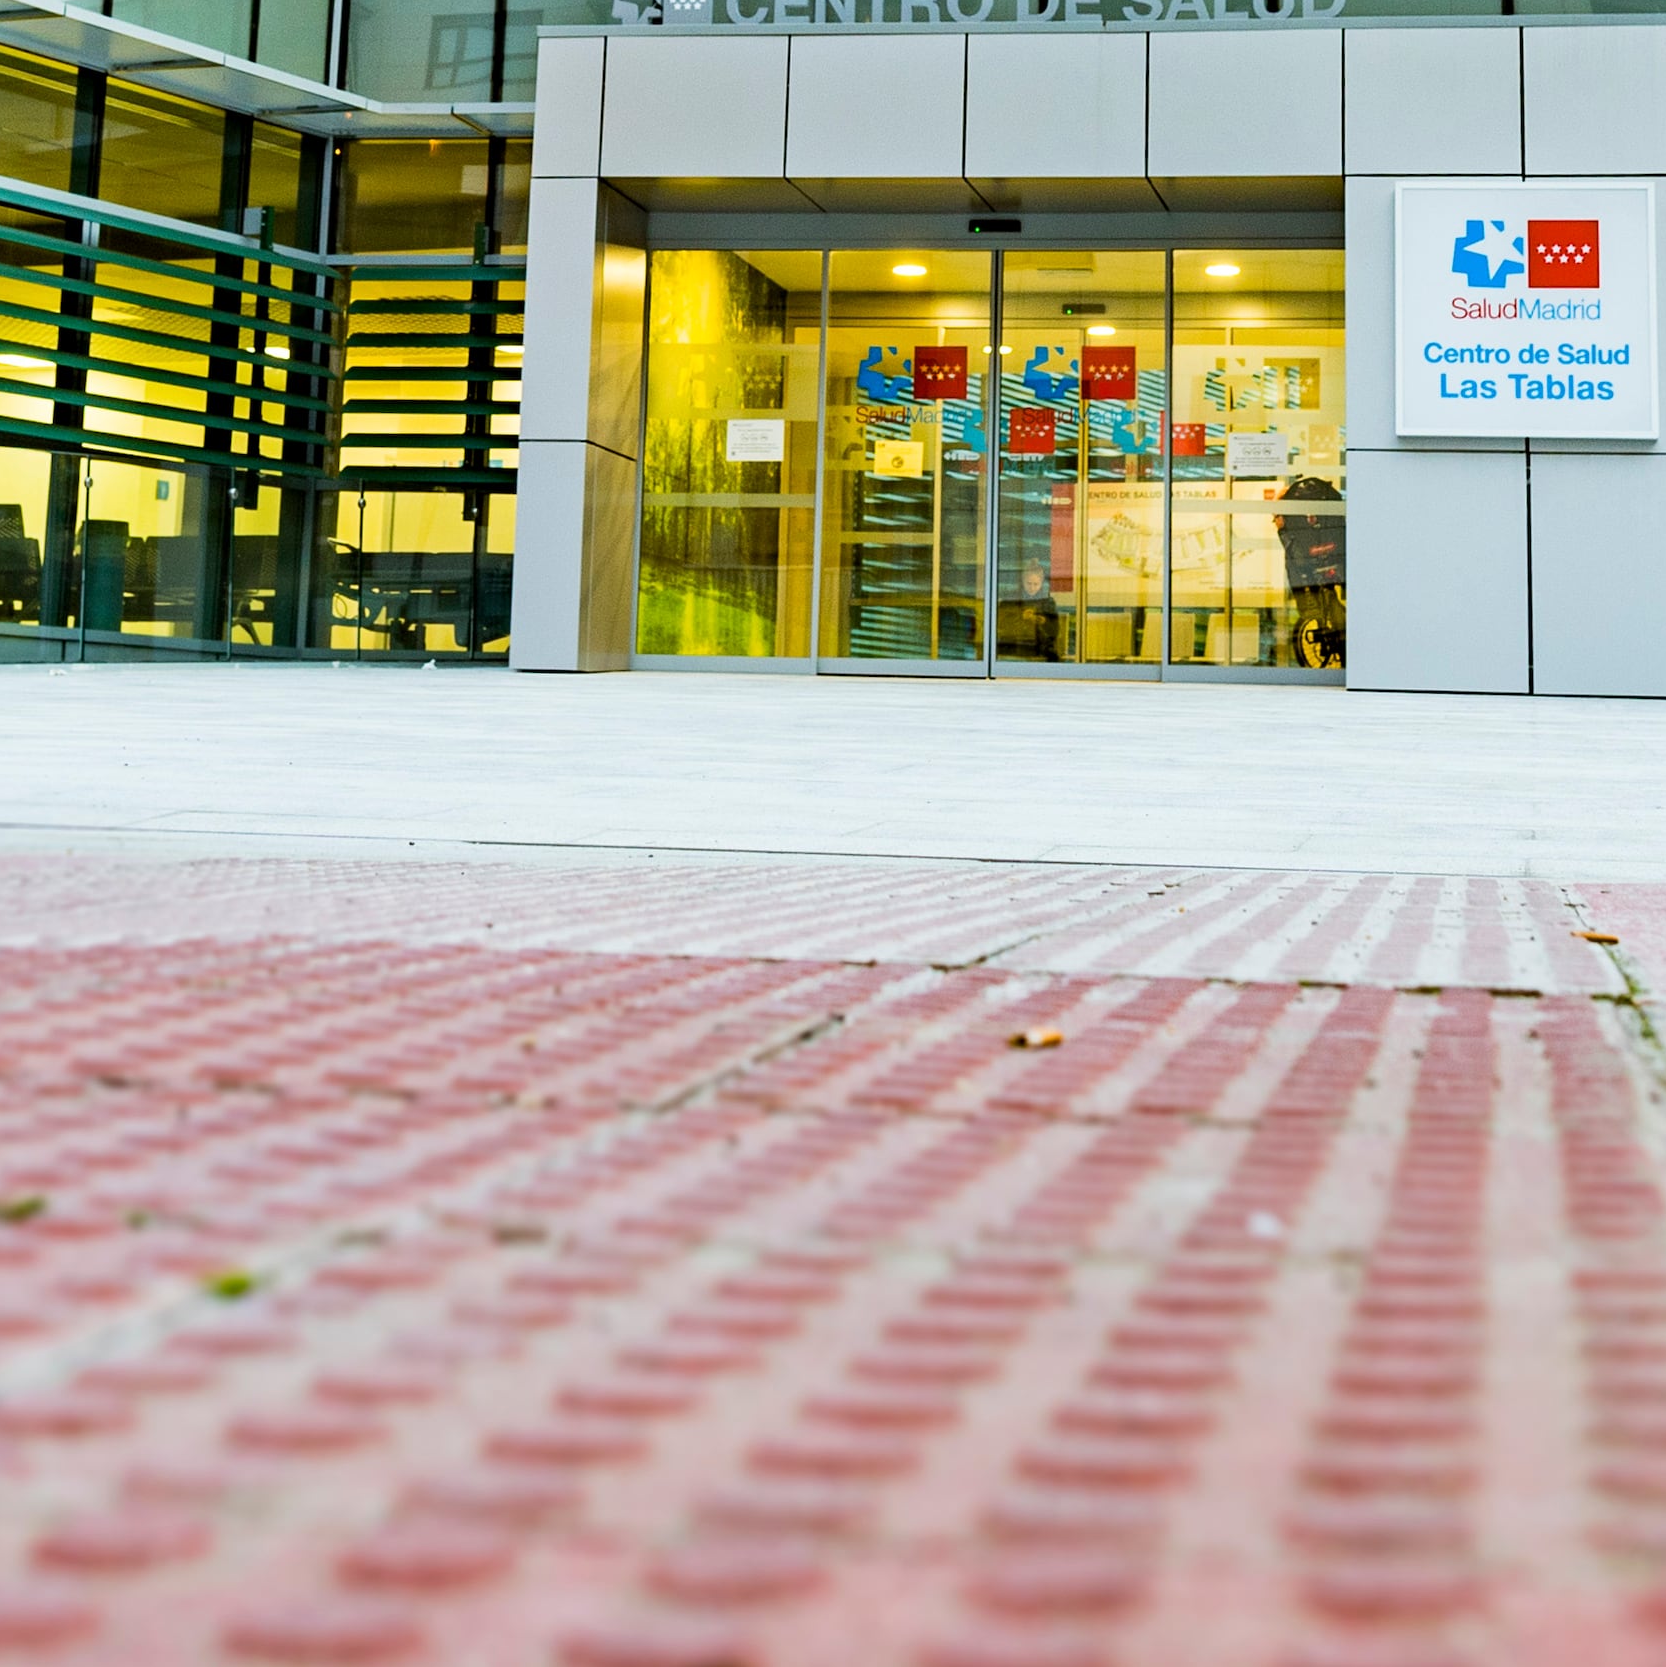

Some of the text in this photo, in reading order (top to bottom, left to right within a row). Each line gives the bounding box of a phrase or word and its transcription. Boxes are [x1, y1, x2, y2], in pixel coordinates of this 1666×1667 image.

[1451, 297, 1601, 320] SaludMadrid
[1423, 342, 1630, 365] Centro de Salud
[1440, 373, 1614, 401] Las Tablas
[1087, 490, 1118, 500] ENTRO
